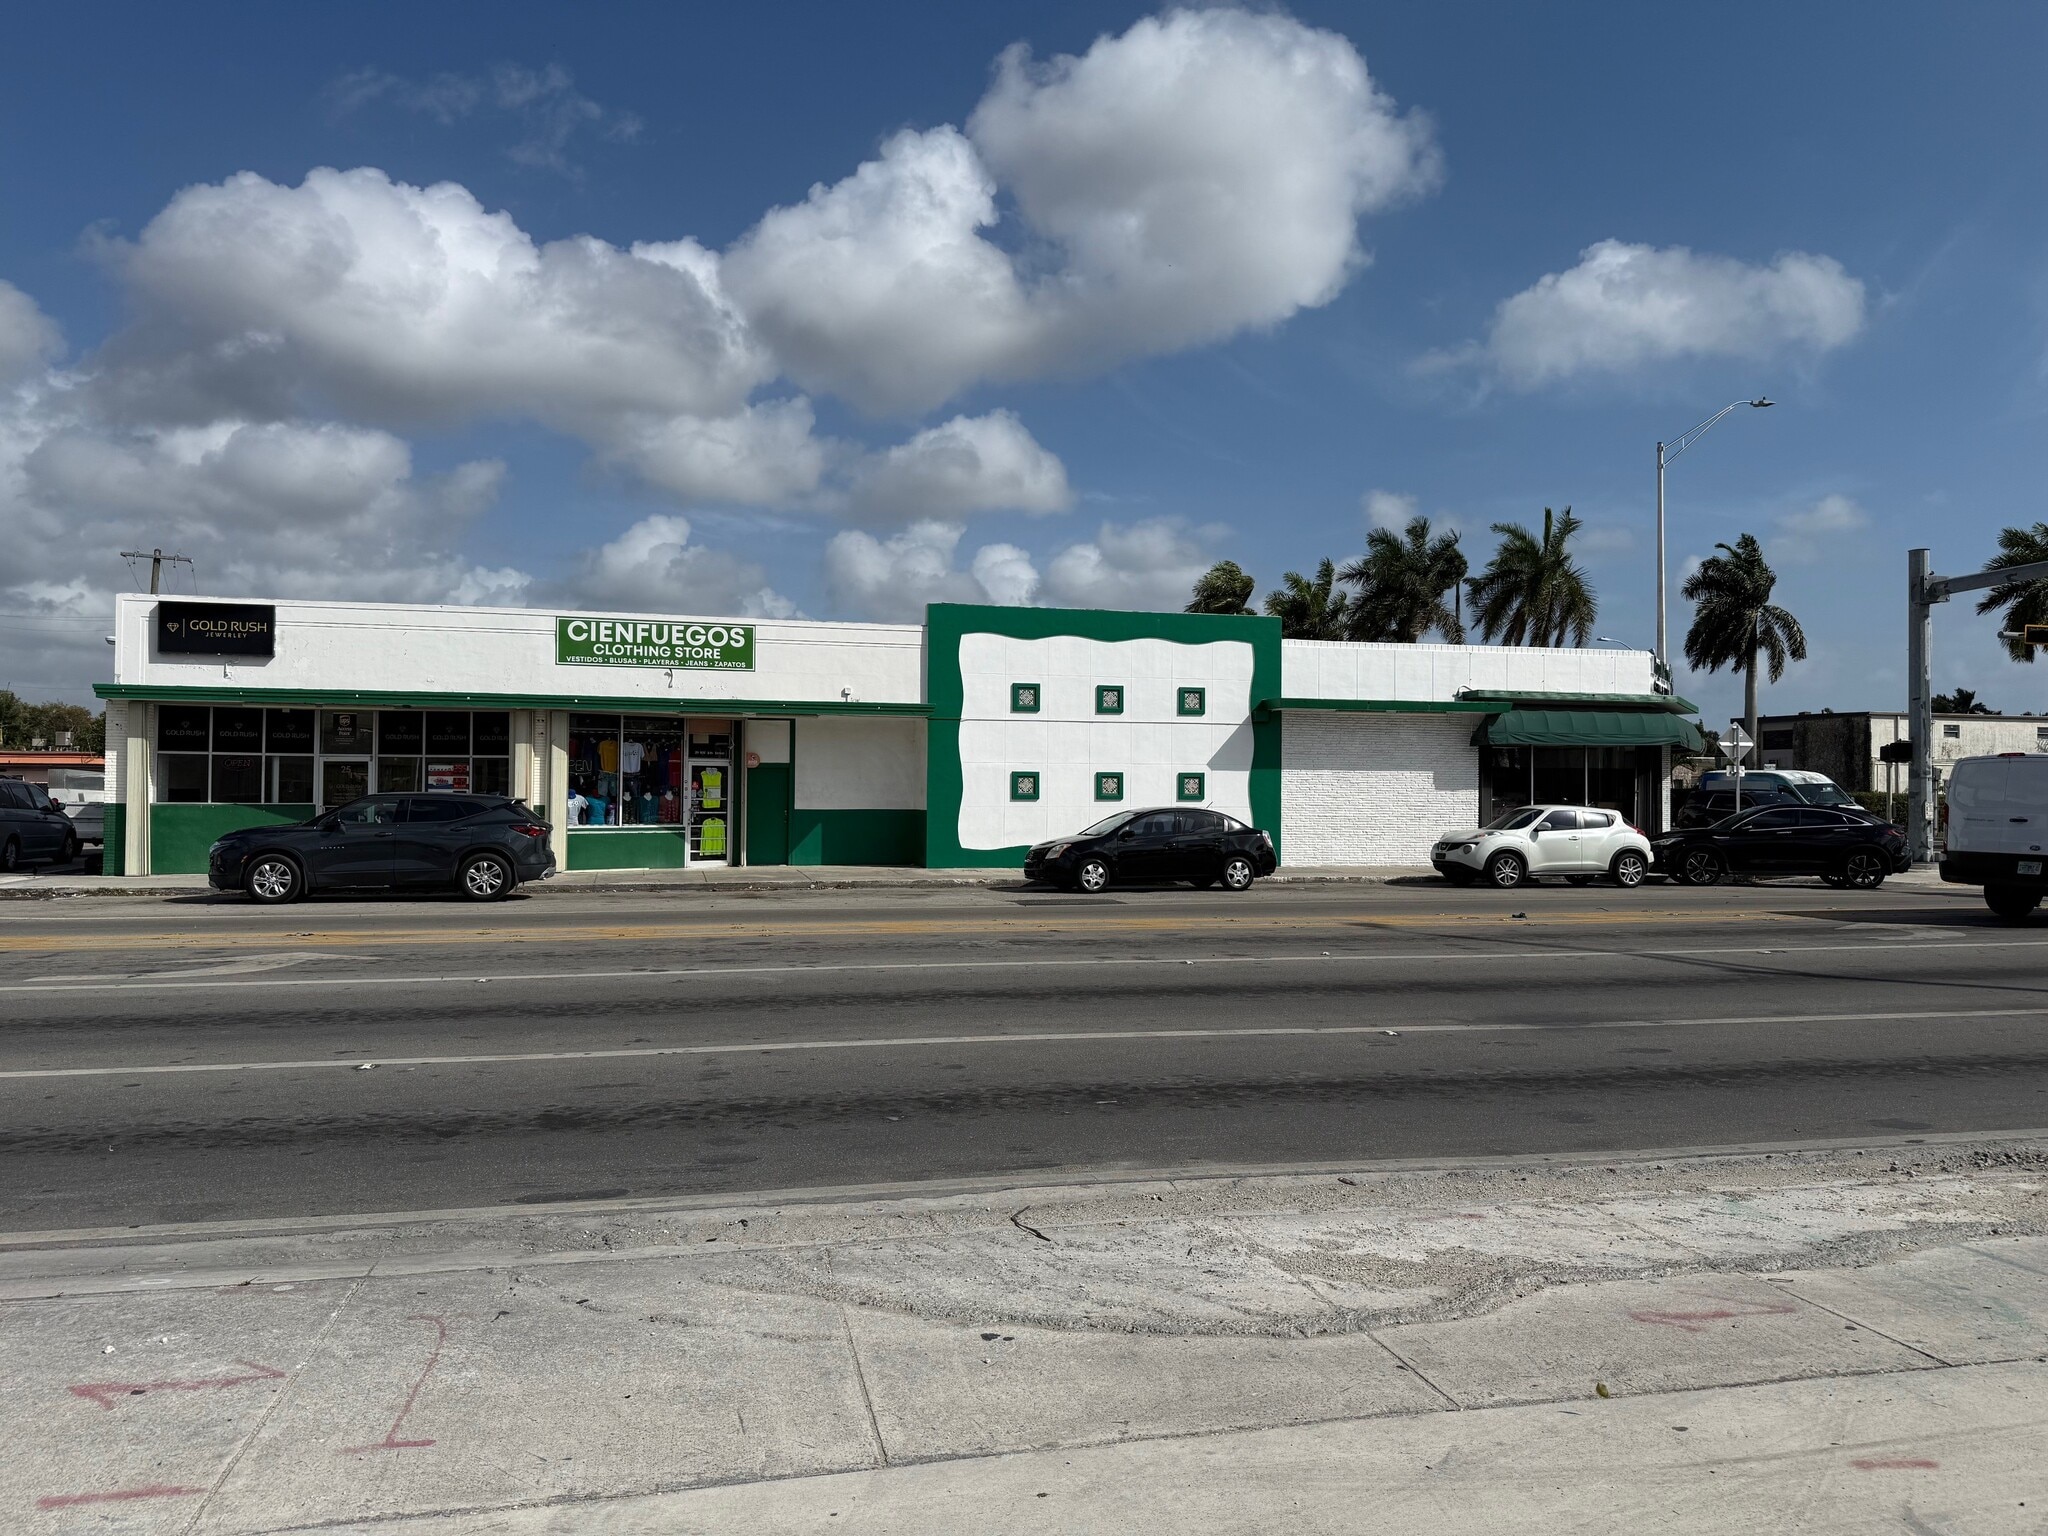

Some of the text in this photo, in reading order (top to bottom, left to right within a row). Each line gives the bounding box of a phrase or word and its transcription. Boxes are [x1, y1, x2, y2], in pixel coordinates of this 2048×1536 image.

[190, 619, 267, 633] GOLD RUSH
[567, 620, 745, 648] CIENFUEGOS
[593, 643, 721, 659] CLOTHING STORE
[566, 655, 603, 663] VESTIDOS
[643, 658, 680, 666] PLAYERAS
[569, 759, 593, 771] PEN
